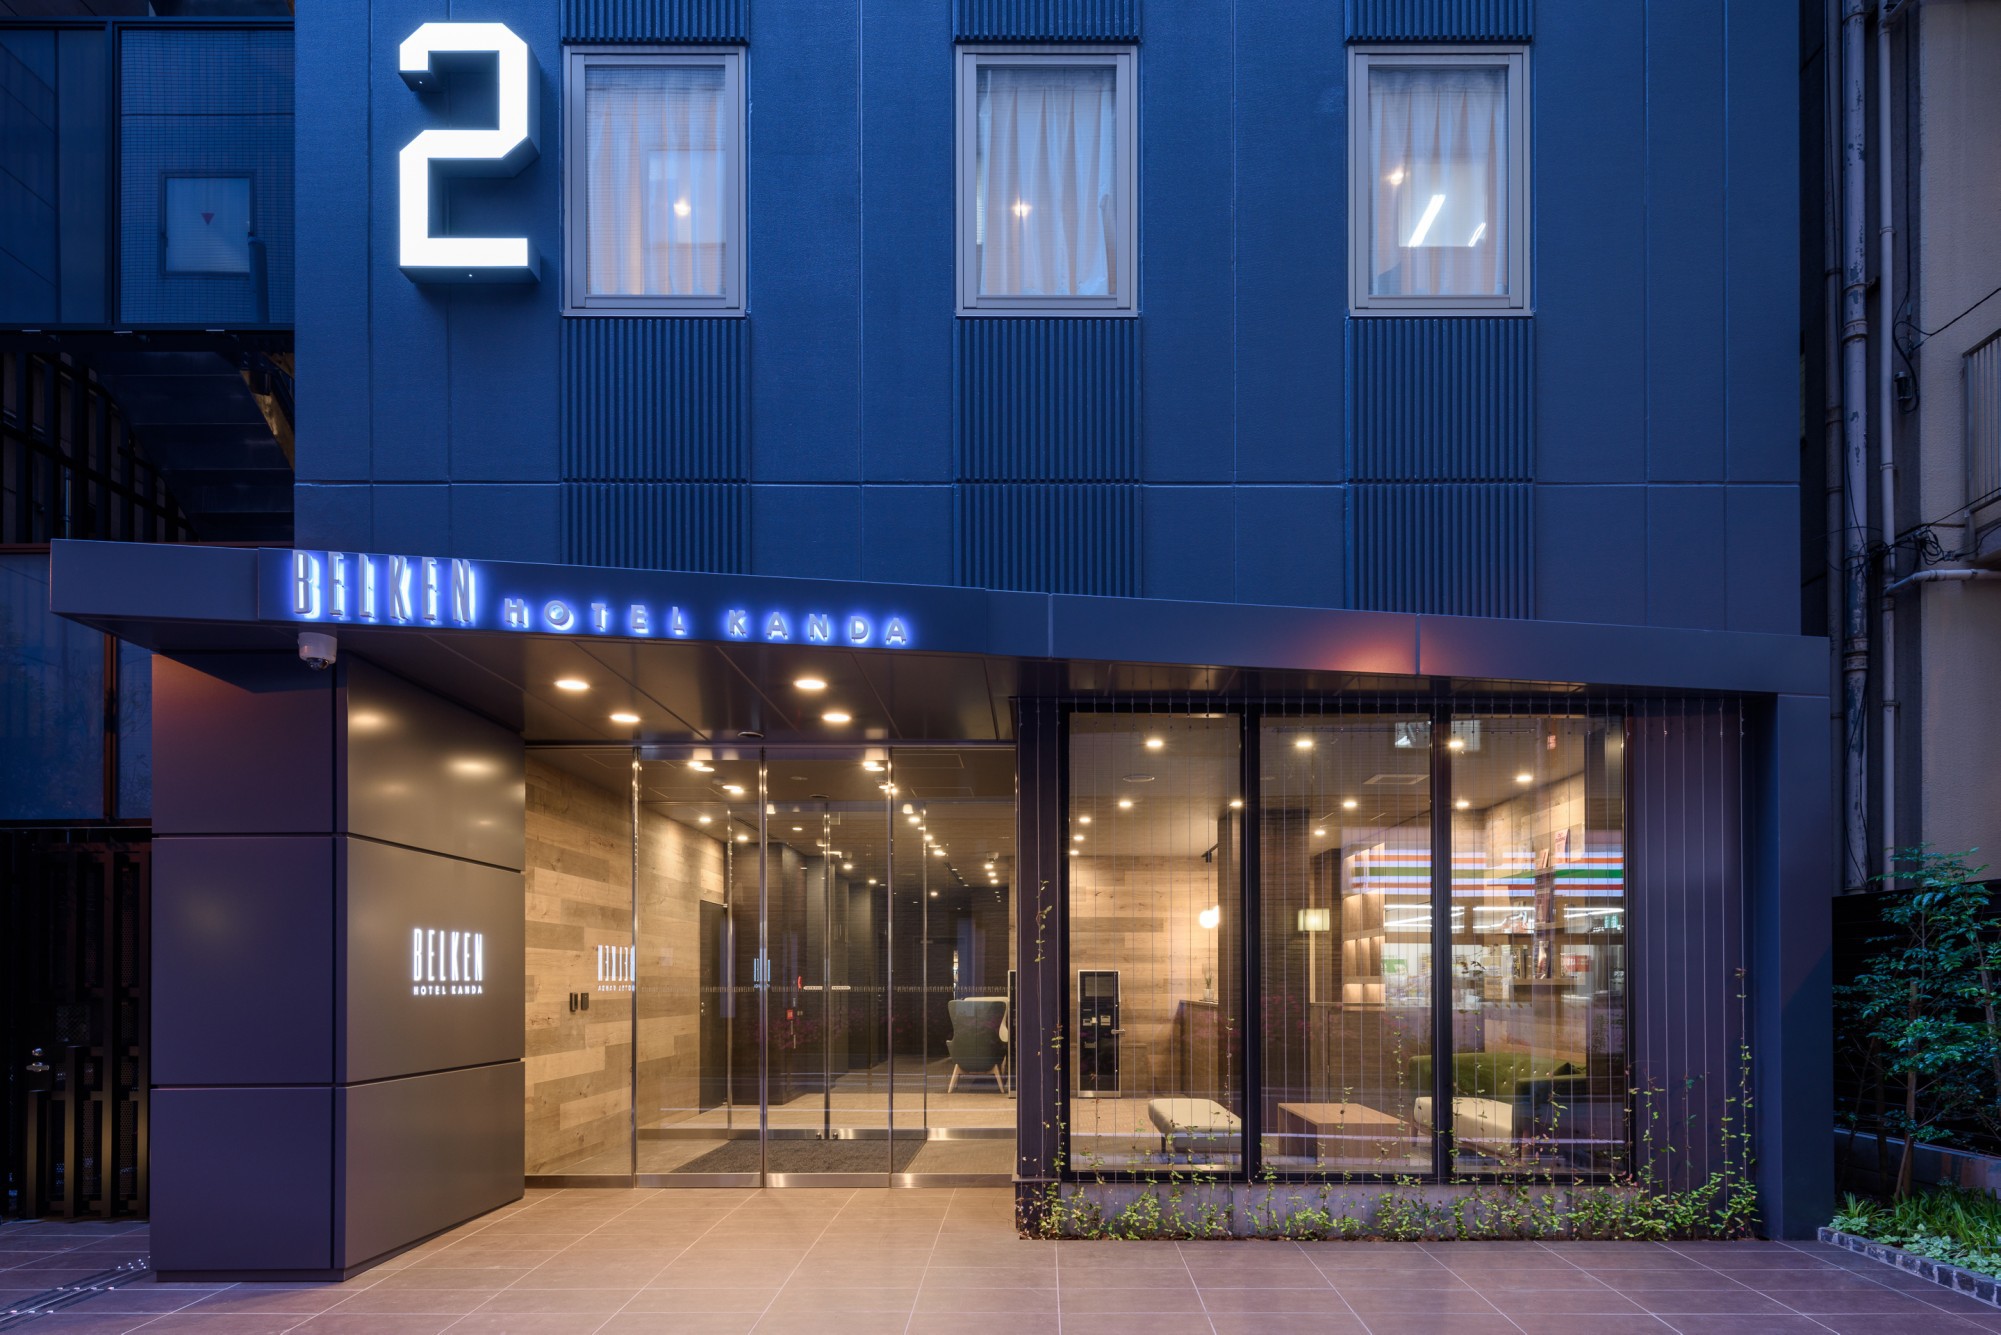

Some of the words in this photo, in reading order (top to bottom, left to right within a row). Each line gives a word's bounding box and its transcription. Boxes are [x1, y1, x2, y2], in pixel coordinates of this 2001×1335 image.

[399, 22, 528, 266] 2
[292, 549, 474, 623] BELKEN
[504, 597, 686, 633] HOTEL
[728, 609, 908, 643] KANDA
[413, 928, 483, 982] BELKEN
[413, 985, 446, 996] HOTEL
[451, 985, 483, 995] KANDA
